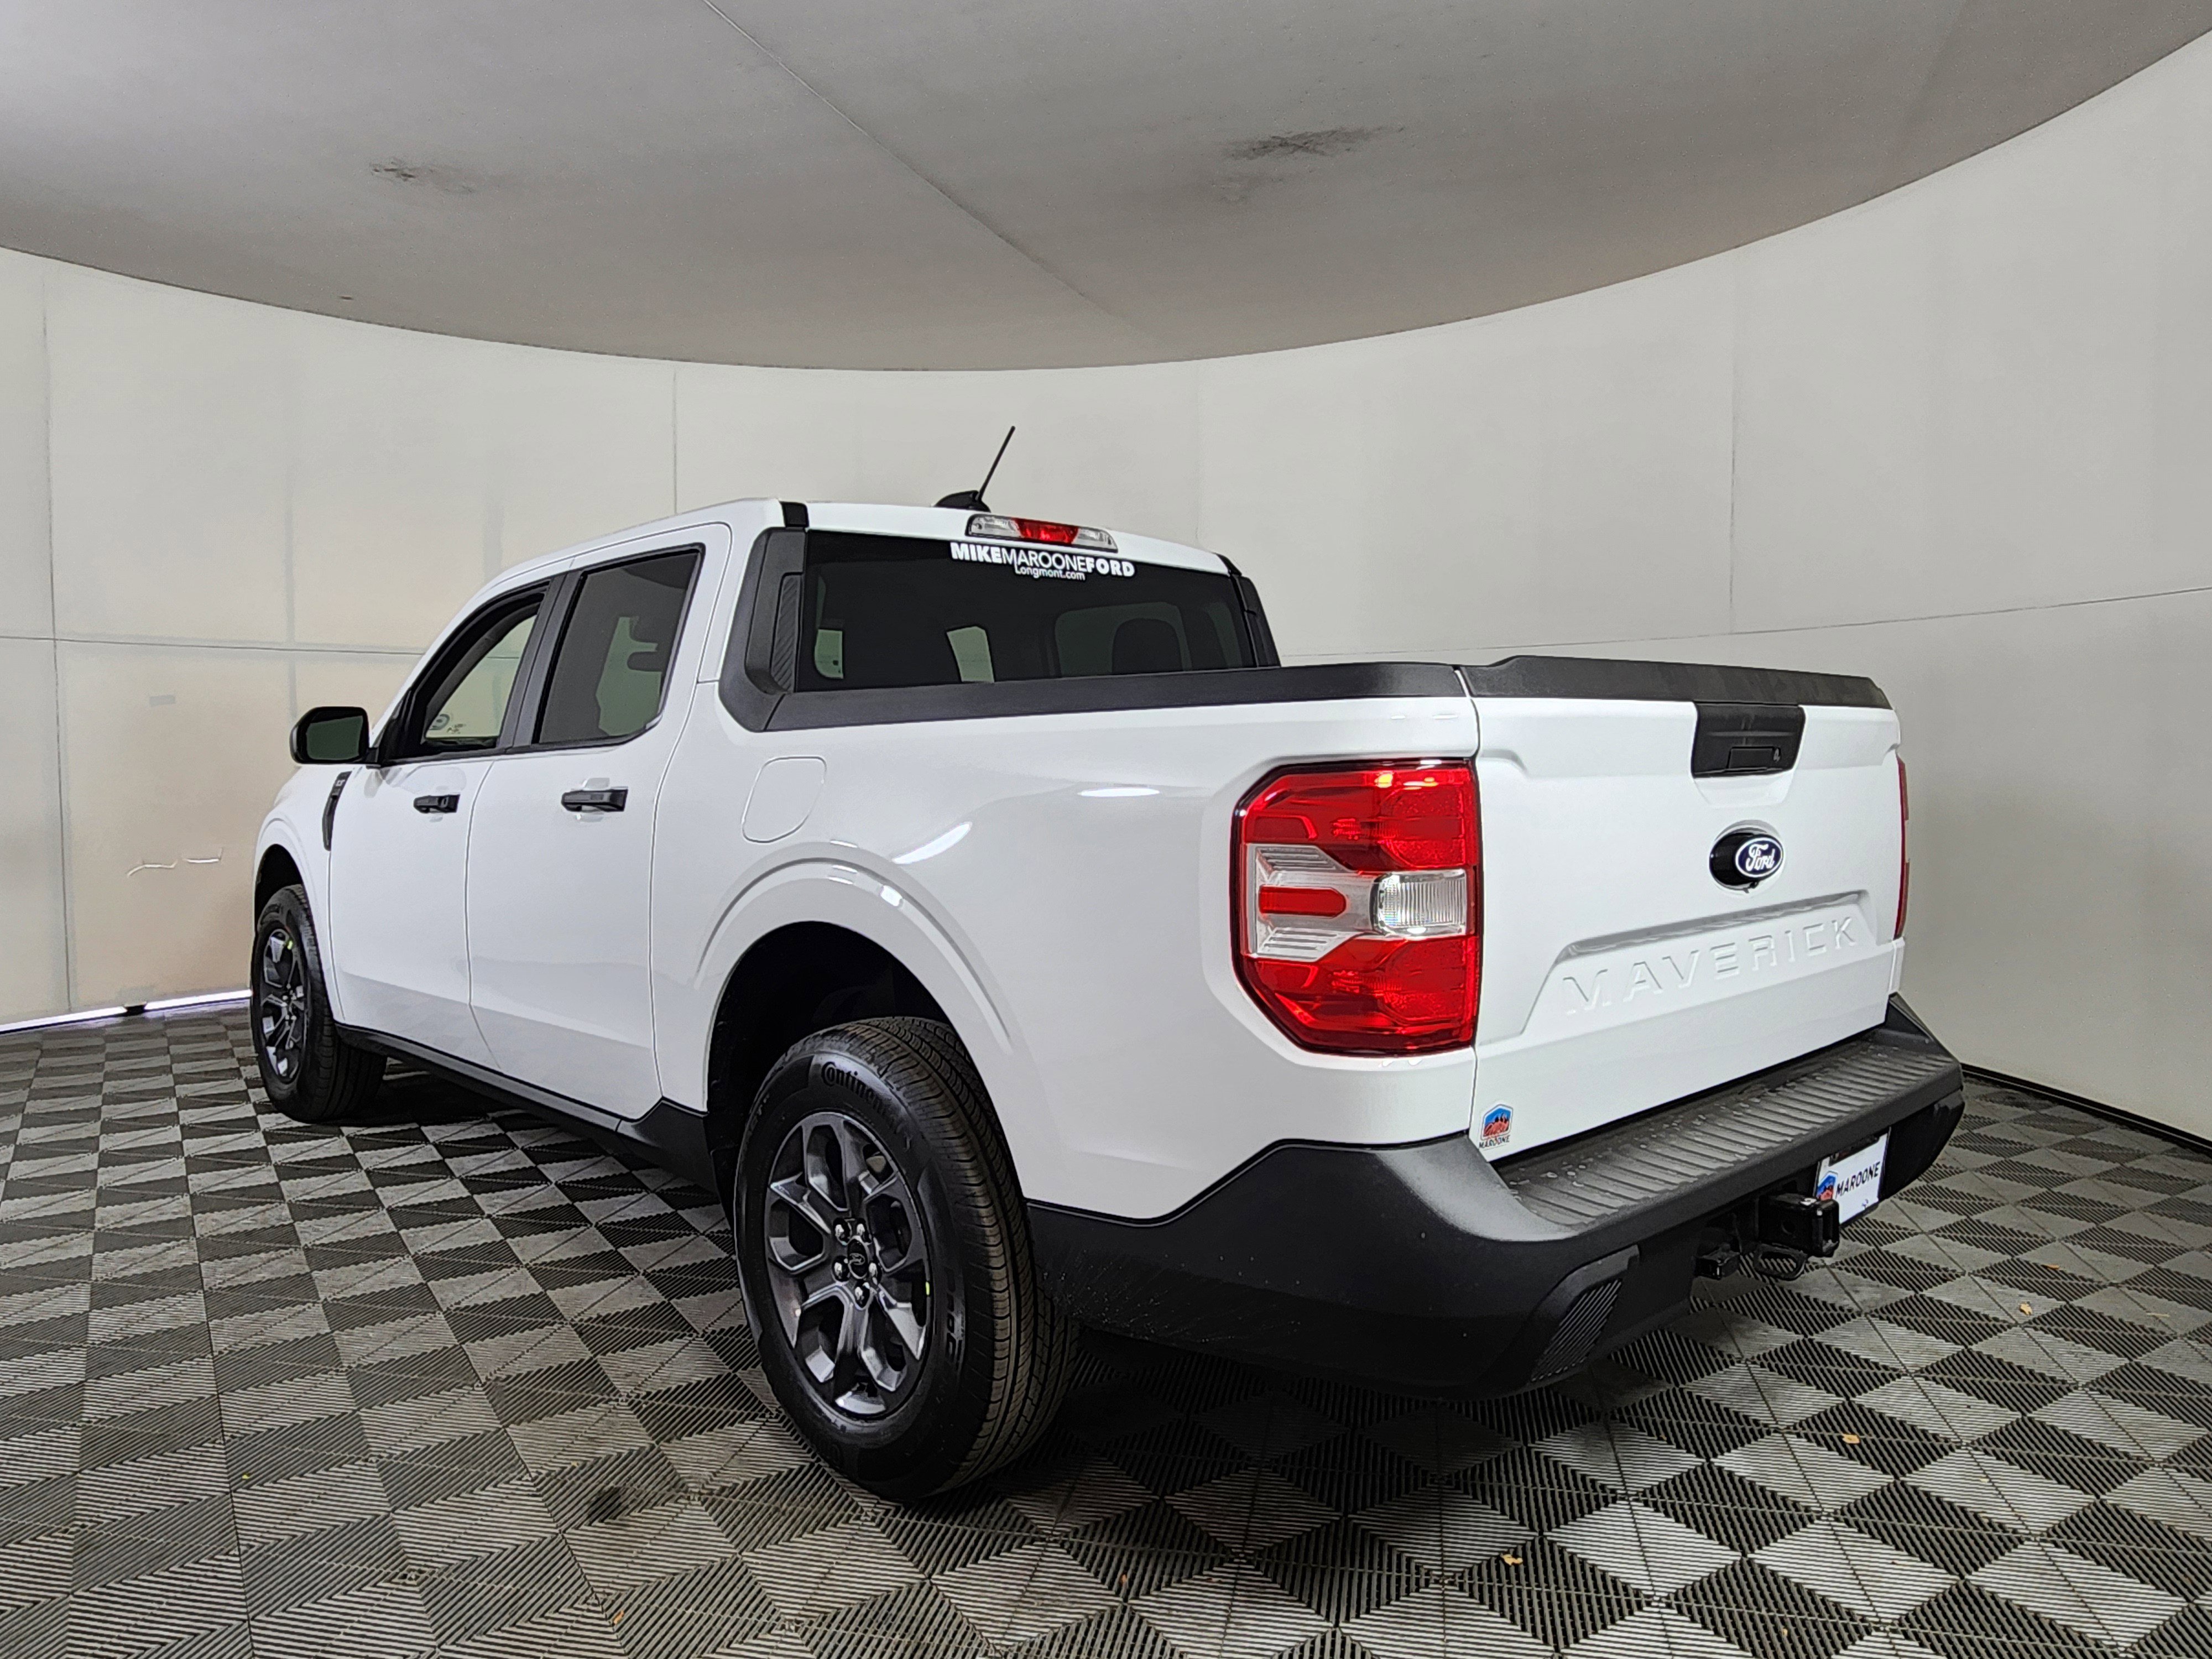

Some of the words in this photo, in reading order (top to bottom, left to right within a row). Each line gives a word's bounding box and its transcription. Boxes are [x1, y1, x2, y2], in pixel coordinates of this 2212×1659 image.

[1014, 565, 1086, 581] Longmont.com
[1745, 843, 1776, 872] Ford
[1561, 916, 1857, 1015] MAVERICK
[1835, 1161, 1881, 1199] MAROONE
